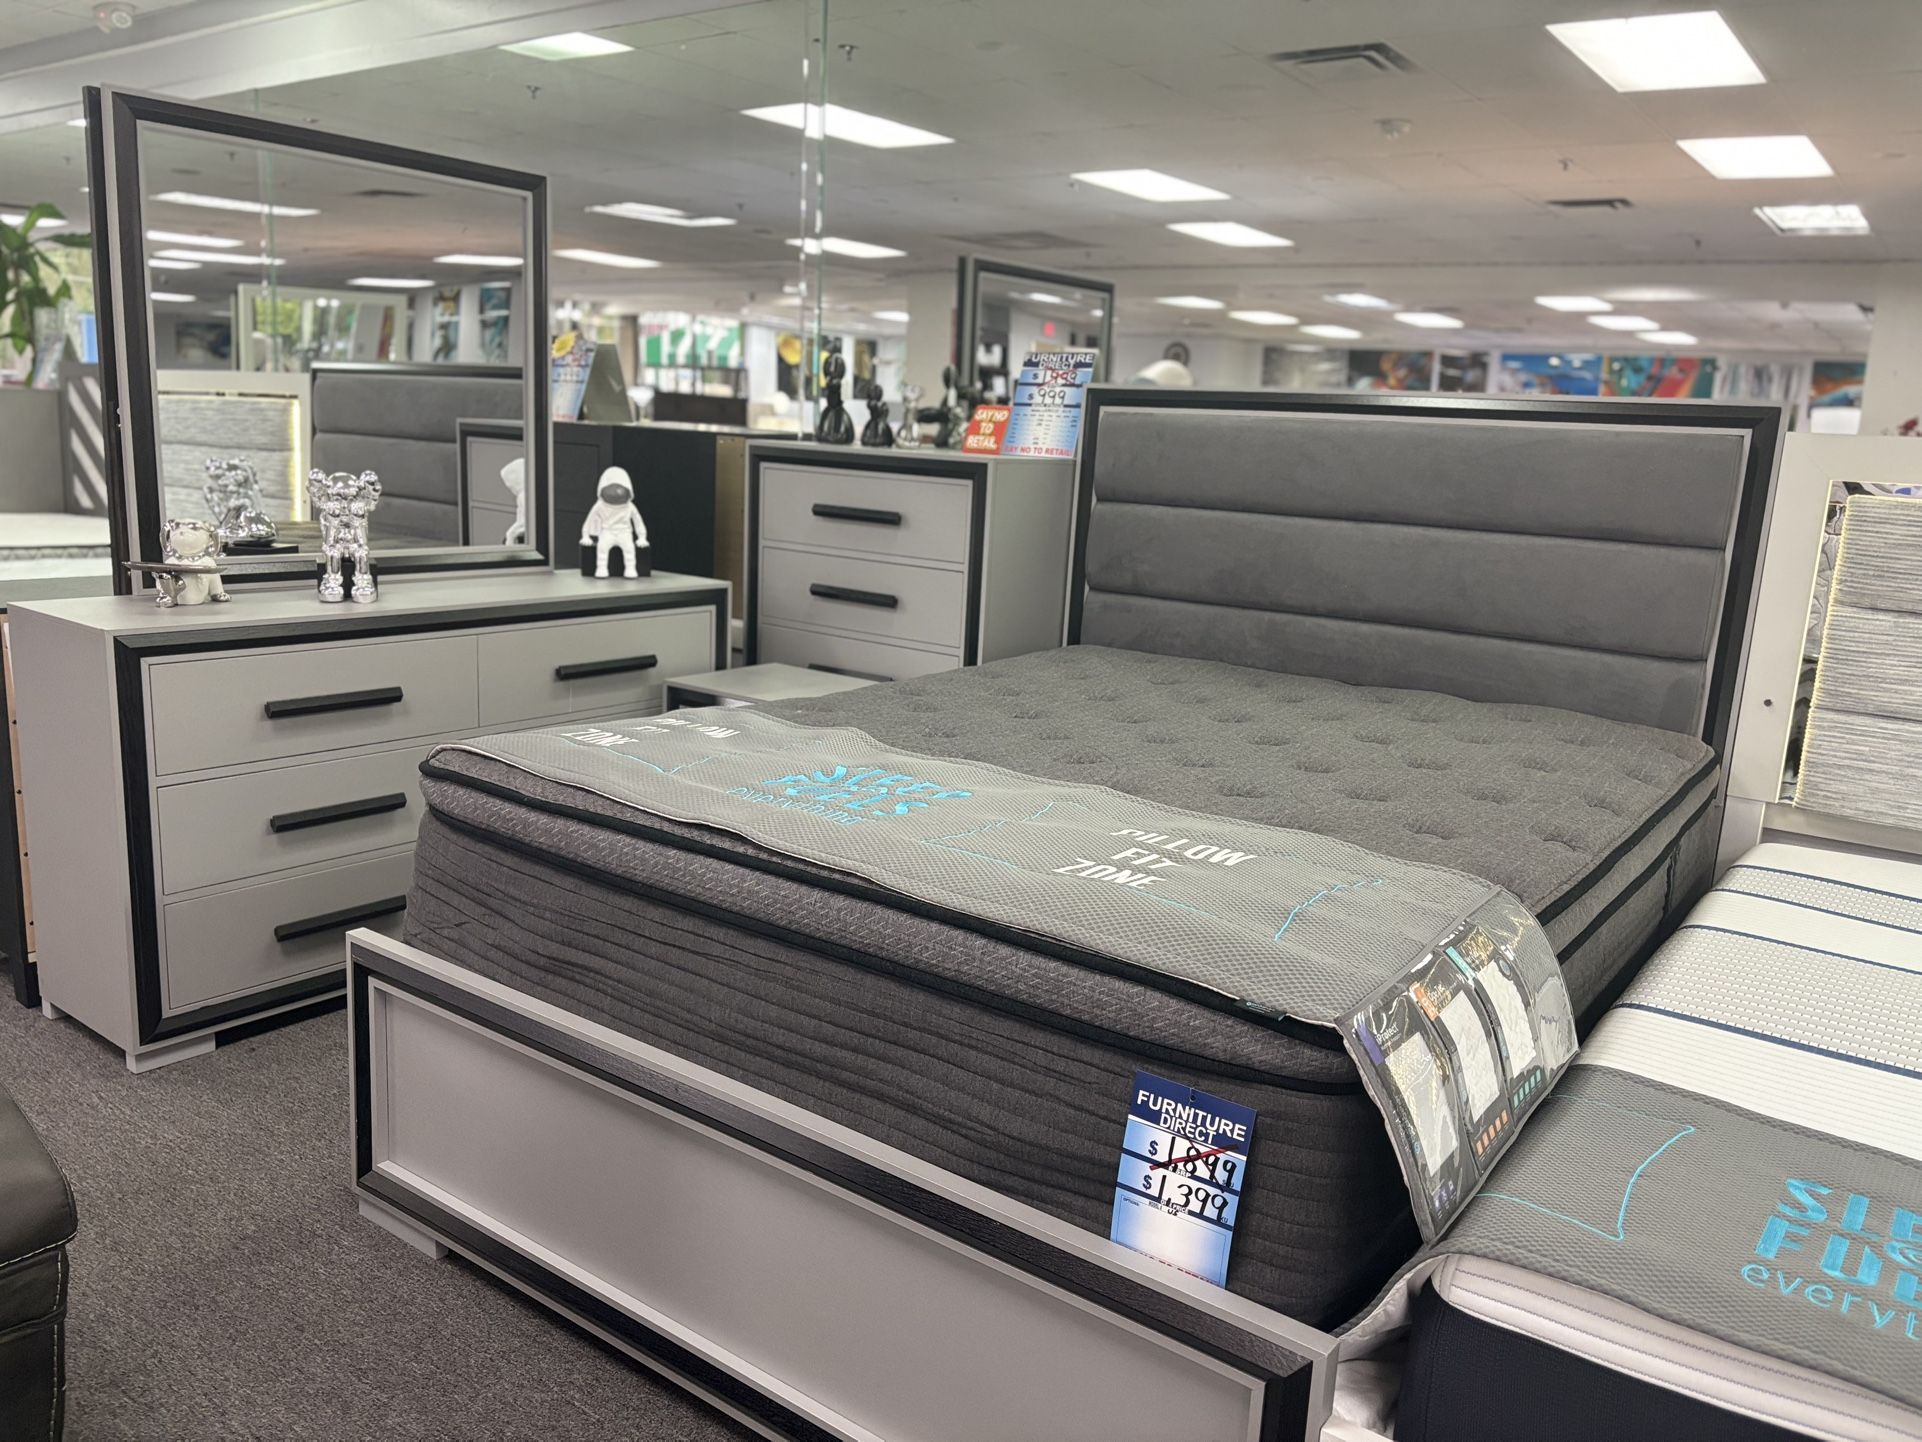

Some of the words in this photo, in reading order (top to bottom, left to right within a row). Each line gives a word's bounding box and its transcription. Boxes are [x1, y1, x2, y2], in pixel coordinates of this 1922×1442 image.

[1025, 353, 1094, 363] FURNITURE
[1039, 362, 1074, 370] DIRECT
[1038, 388, 1066, 404] 999
[975, 410, 993, 420] SAY
[993, 410, 1010, 421] NO
[979, 422, 995, 434] TO
[966, 436, 998, 449] RETAIL
[1109, 829, 1258, 867] PILLOW
[1110, 847, 1184, 869] FIT
[1051, 857, 1168, 889] ZONE
[1136, 1089, 1248, 1142] FURNITURE
[1159, 1113, 1218, 1145] DIRECT
[1148, 1140, 1159, 1157] $
[1142, 1174, 1153, 1191] $
[1158, 1174, 1229, 1222] 1,399
